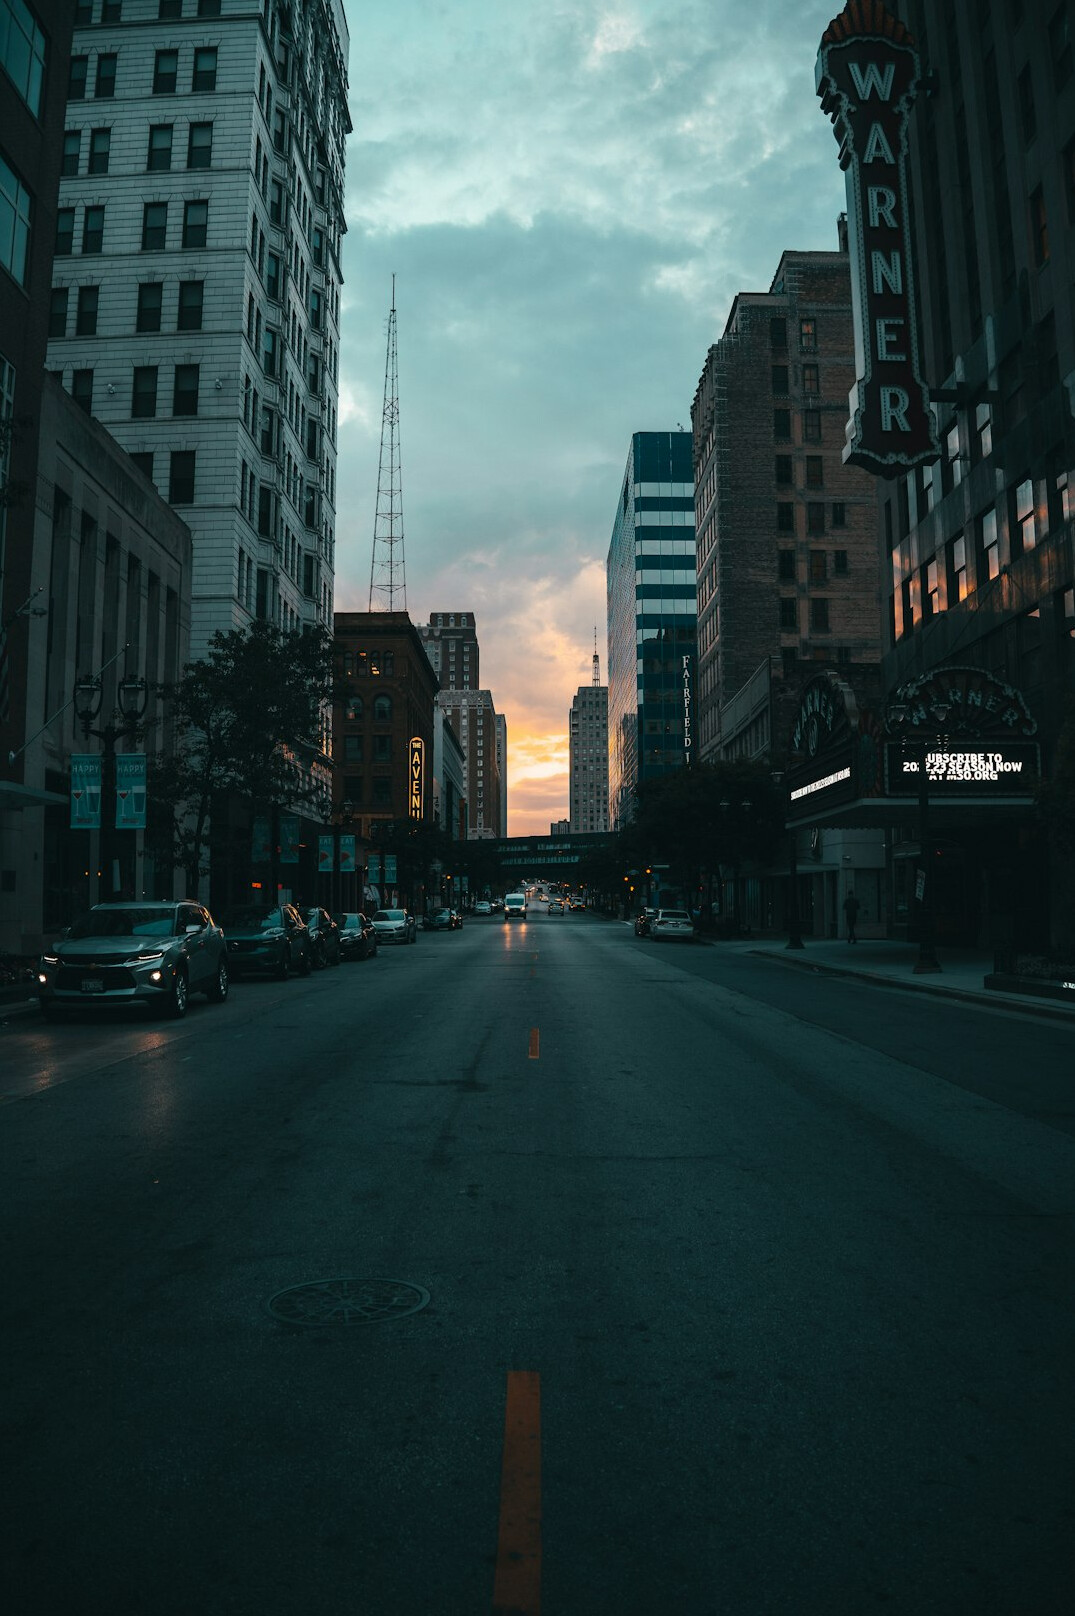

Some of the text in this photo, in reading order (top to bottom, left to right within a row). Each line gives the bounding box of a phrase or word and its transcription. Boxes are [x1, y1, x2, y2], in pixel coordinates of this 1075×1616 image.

[847, 61, 912, 433] WARNER
[682, 655, 692, 748] FAIRFIELD
[911, 687, 1018, 726] WRNER
[925, 753, 1003, 763] UBSCRIBE TO
[72, 765, 98, 773] HAPPY
[118, 764, 144, 773] HAPPY
[948, 762, 994, 772] SEASON
[995, 762, 1023, 772] NOW
